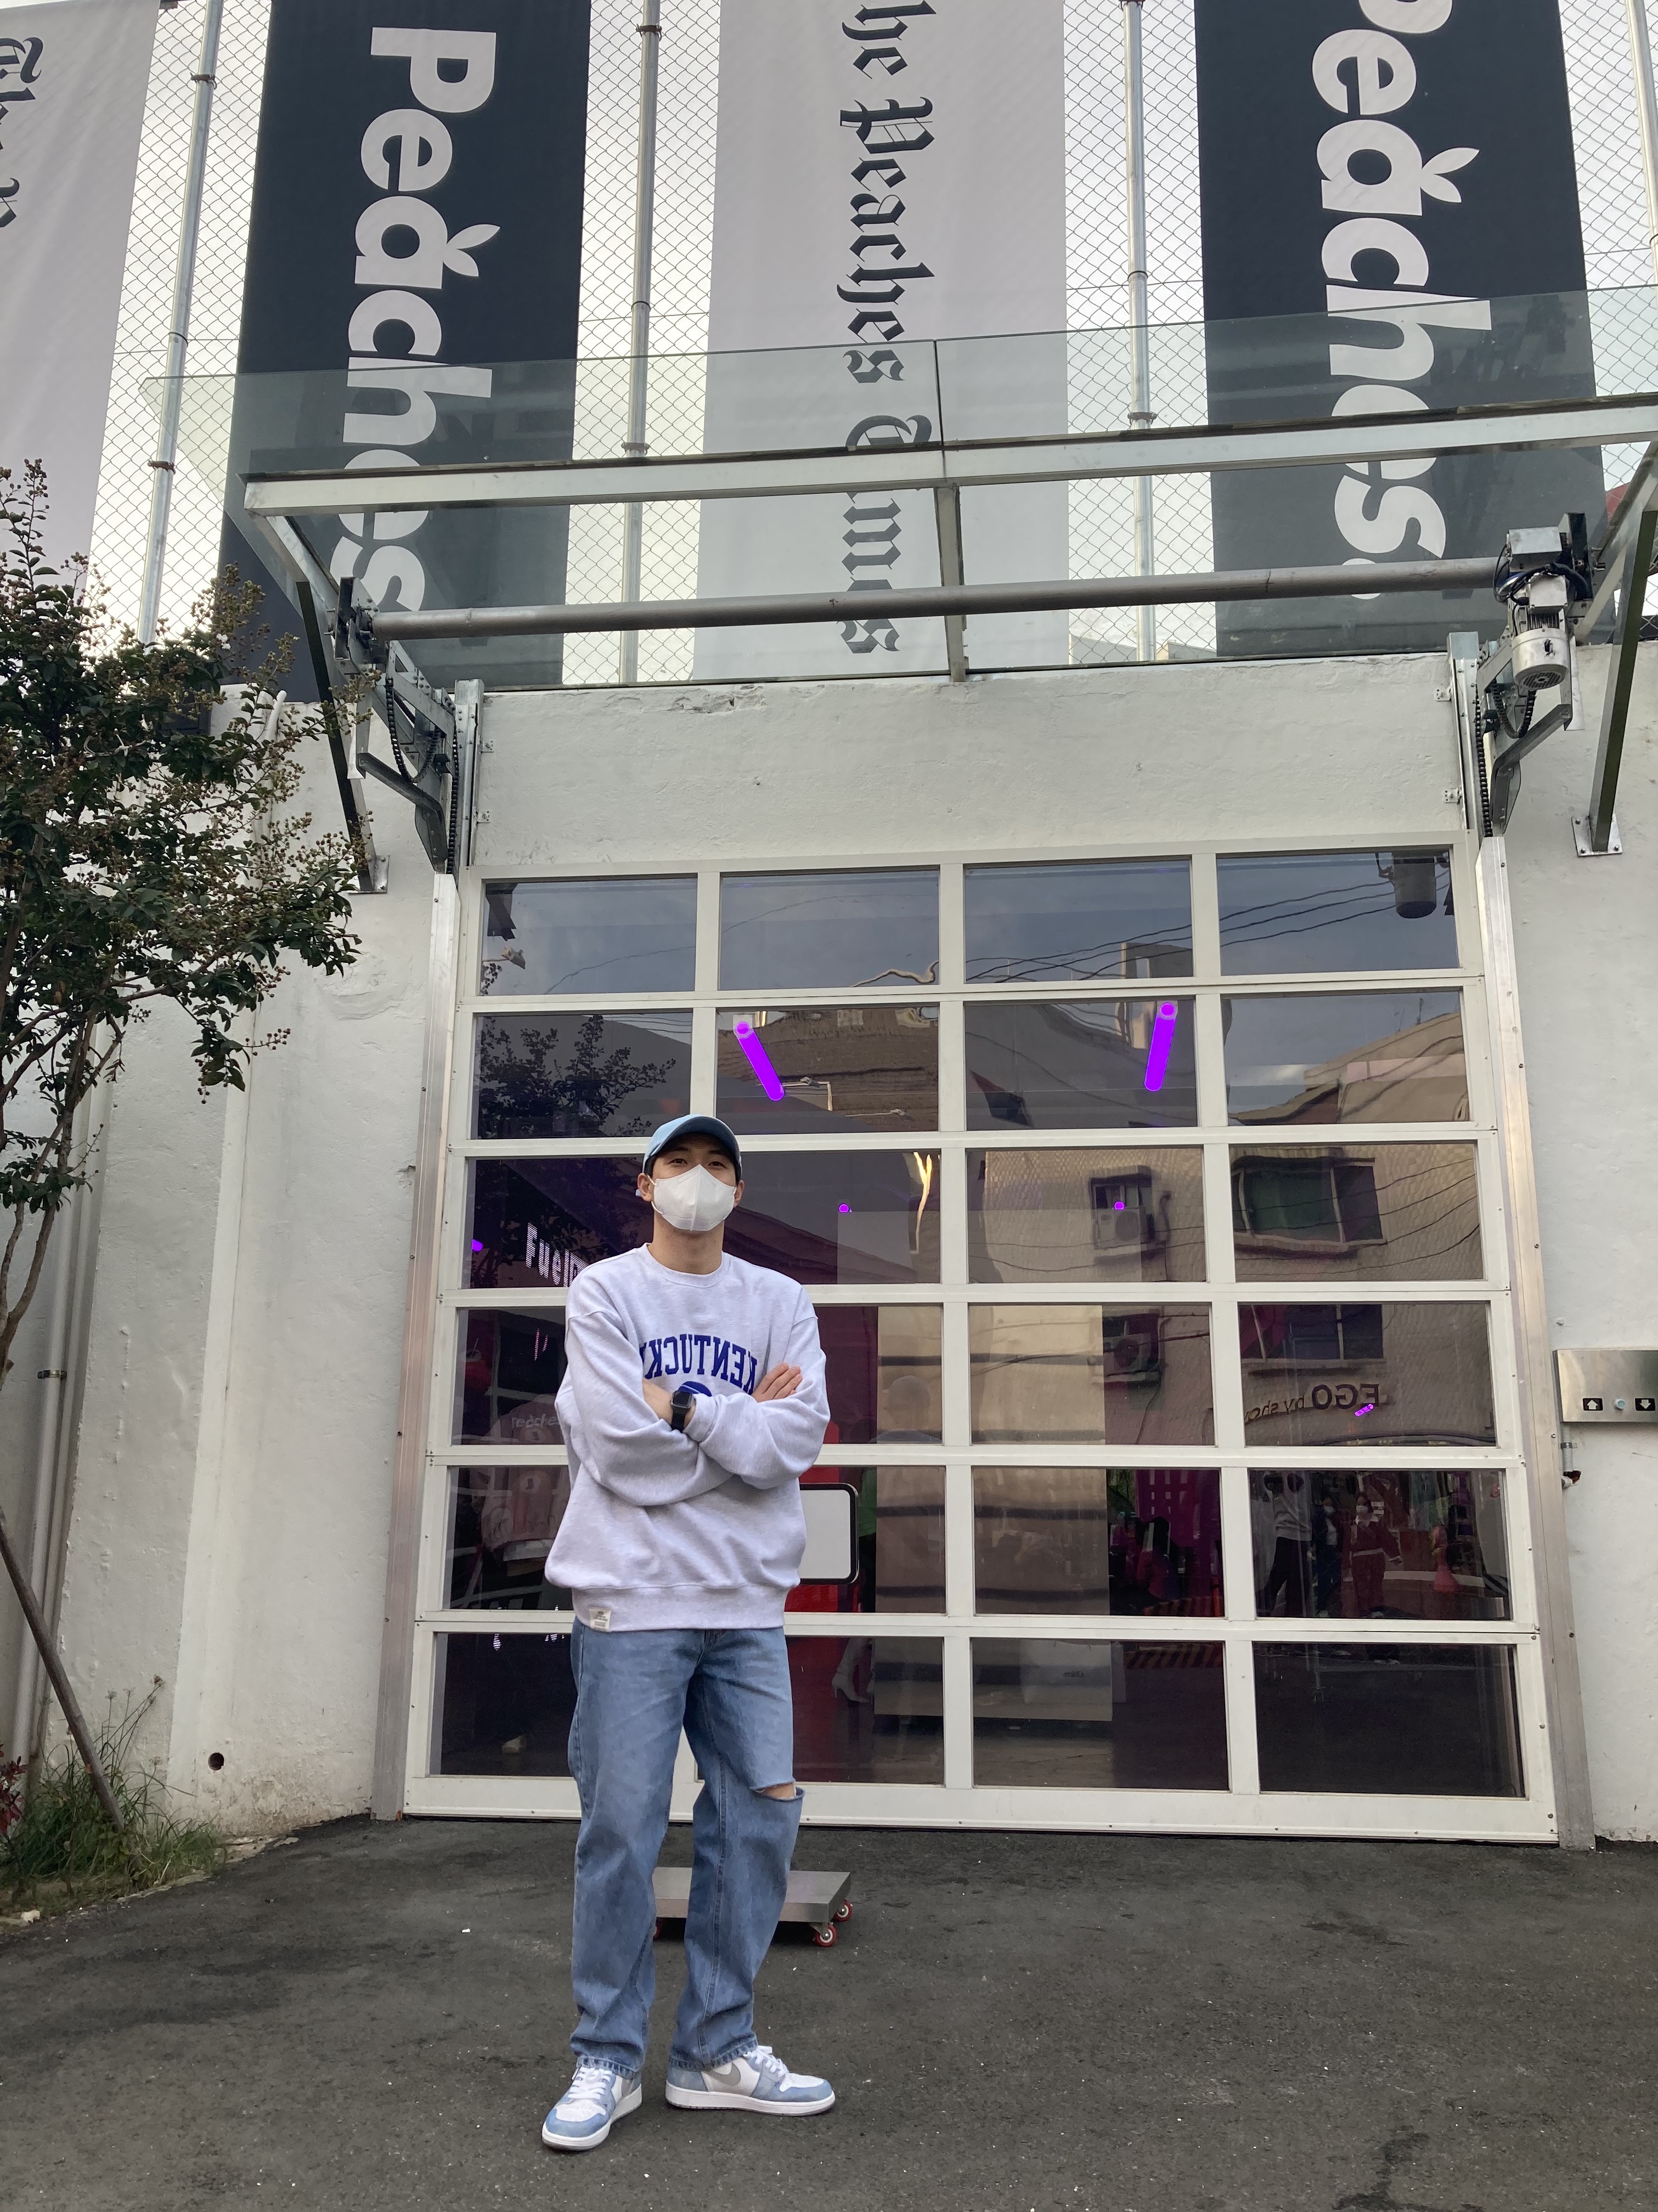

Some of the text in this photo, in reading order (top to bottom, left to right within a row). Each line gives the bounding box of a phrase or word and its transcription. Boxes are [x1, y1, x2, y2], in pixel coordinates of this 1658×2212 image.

[836, 96, 935, 383] Peaches
[836, 415, 932, 654] Tms
[511, 1413, 560, 1428] eache
